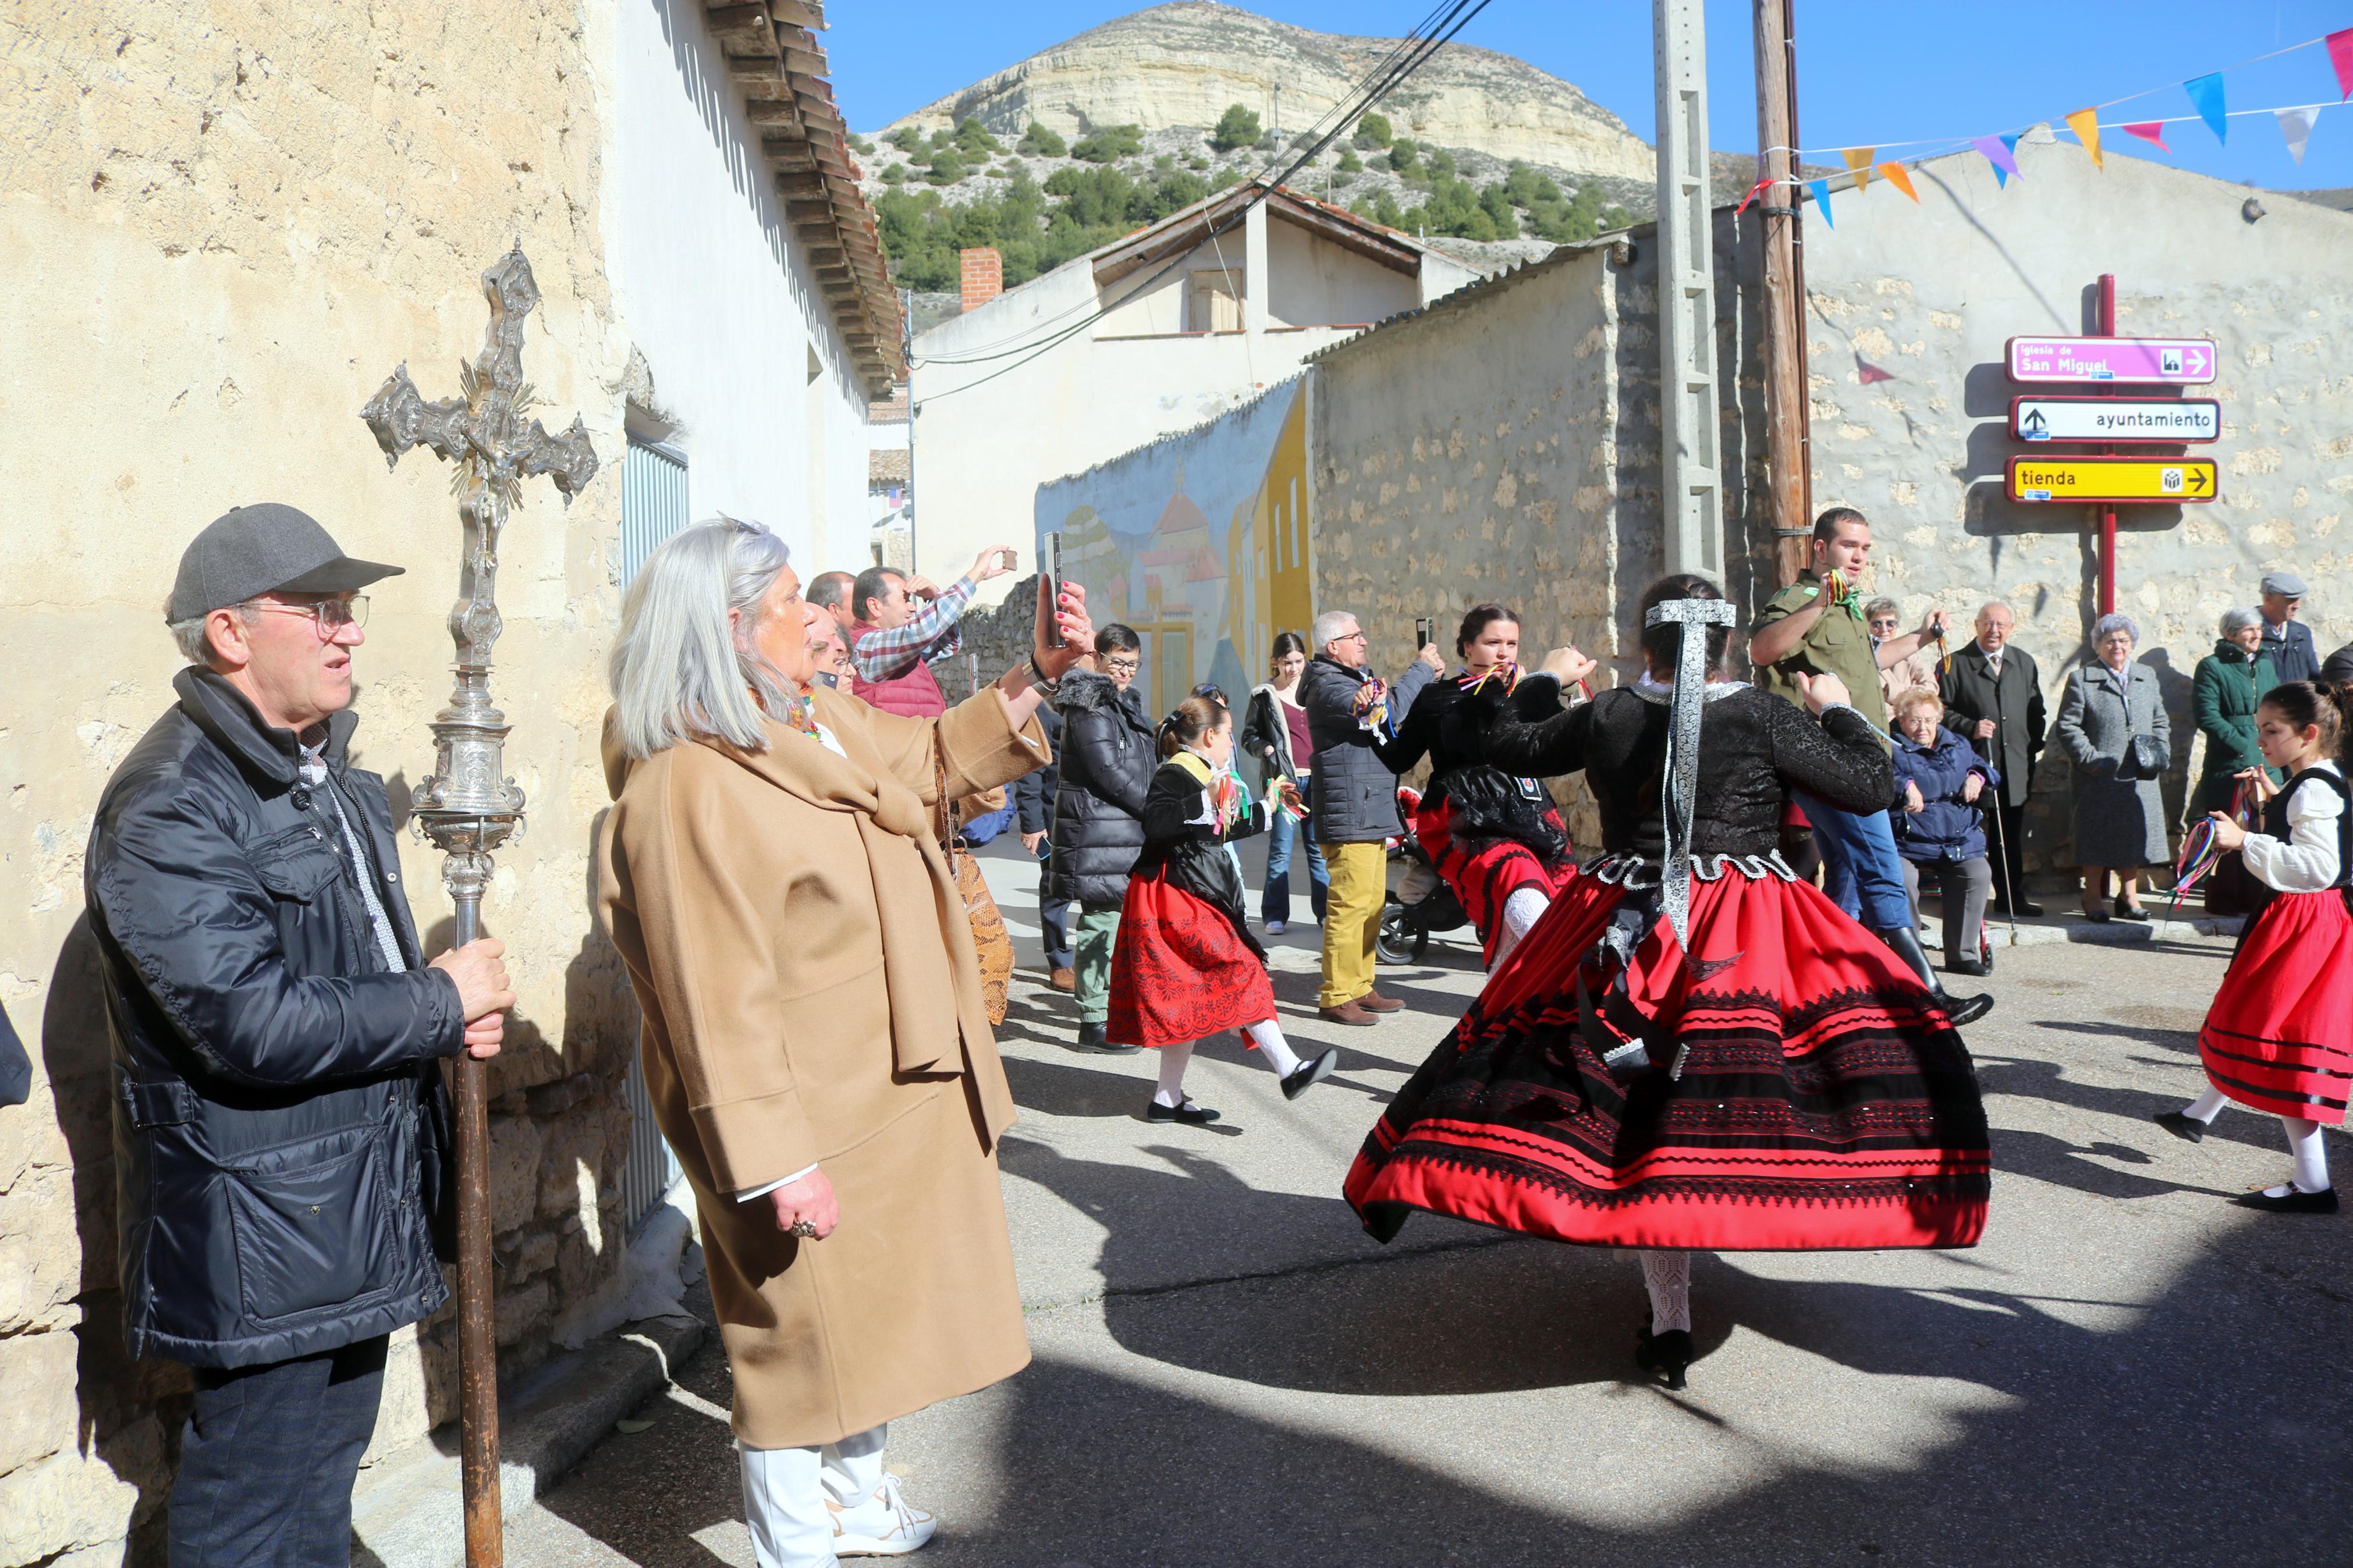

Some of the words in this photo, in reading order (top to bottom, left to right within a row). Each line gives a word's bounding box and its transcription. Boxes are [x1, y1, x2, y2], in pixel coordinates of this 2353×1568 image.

[2060, 346, 2072, 355] de
[2021, 358, 2050, 371] San
[2059, 358, 2107, 375] Miguel
[2097, 412, 2210, 429] ayuntamiento
[2022, 471, 2076, 485] tienda
